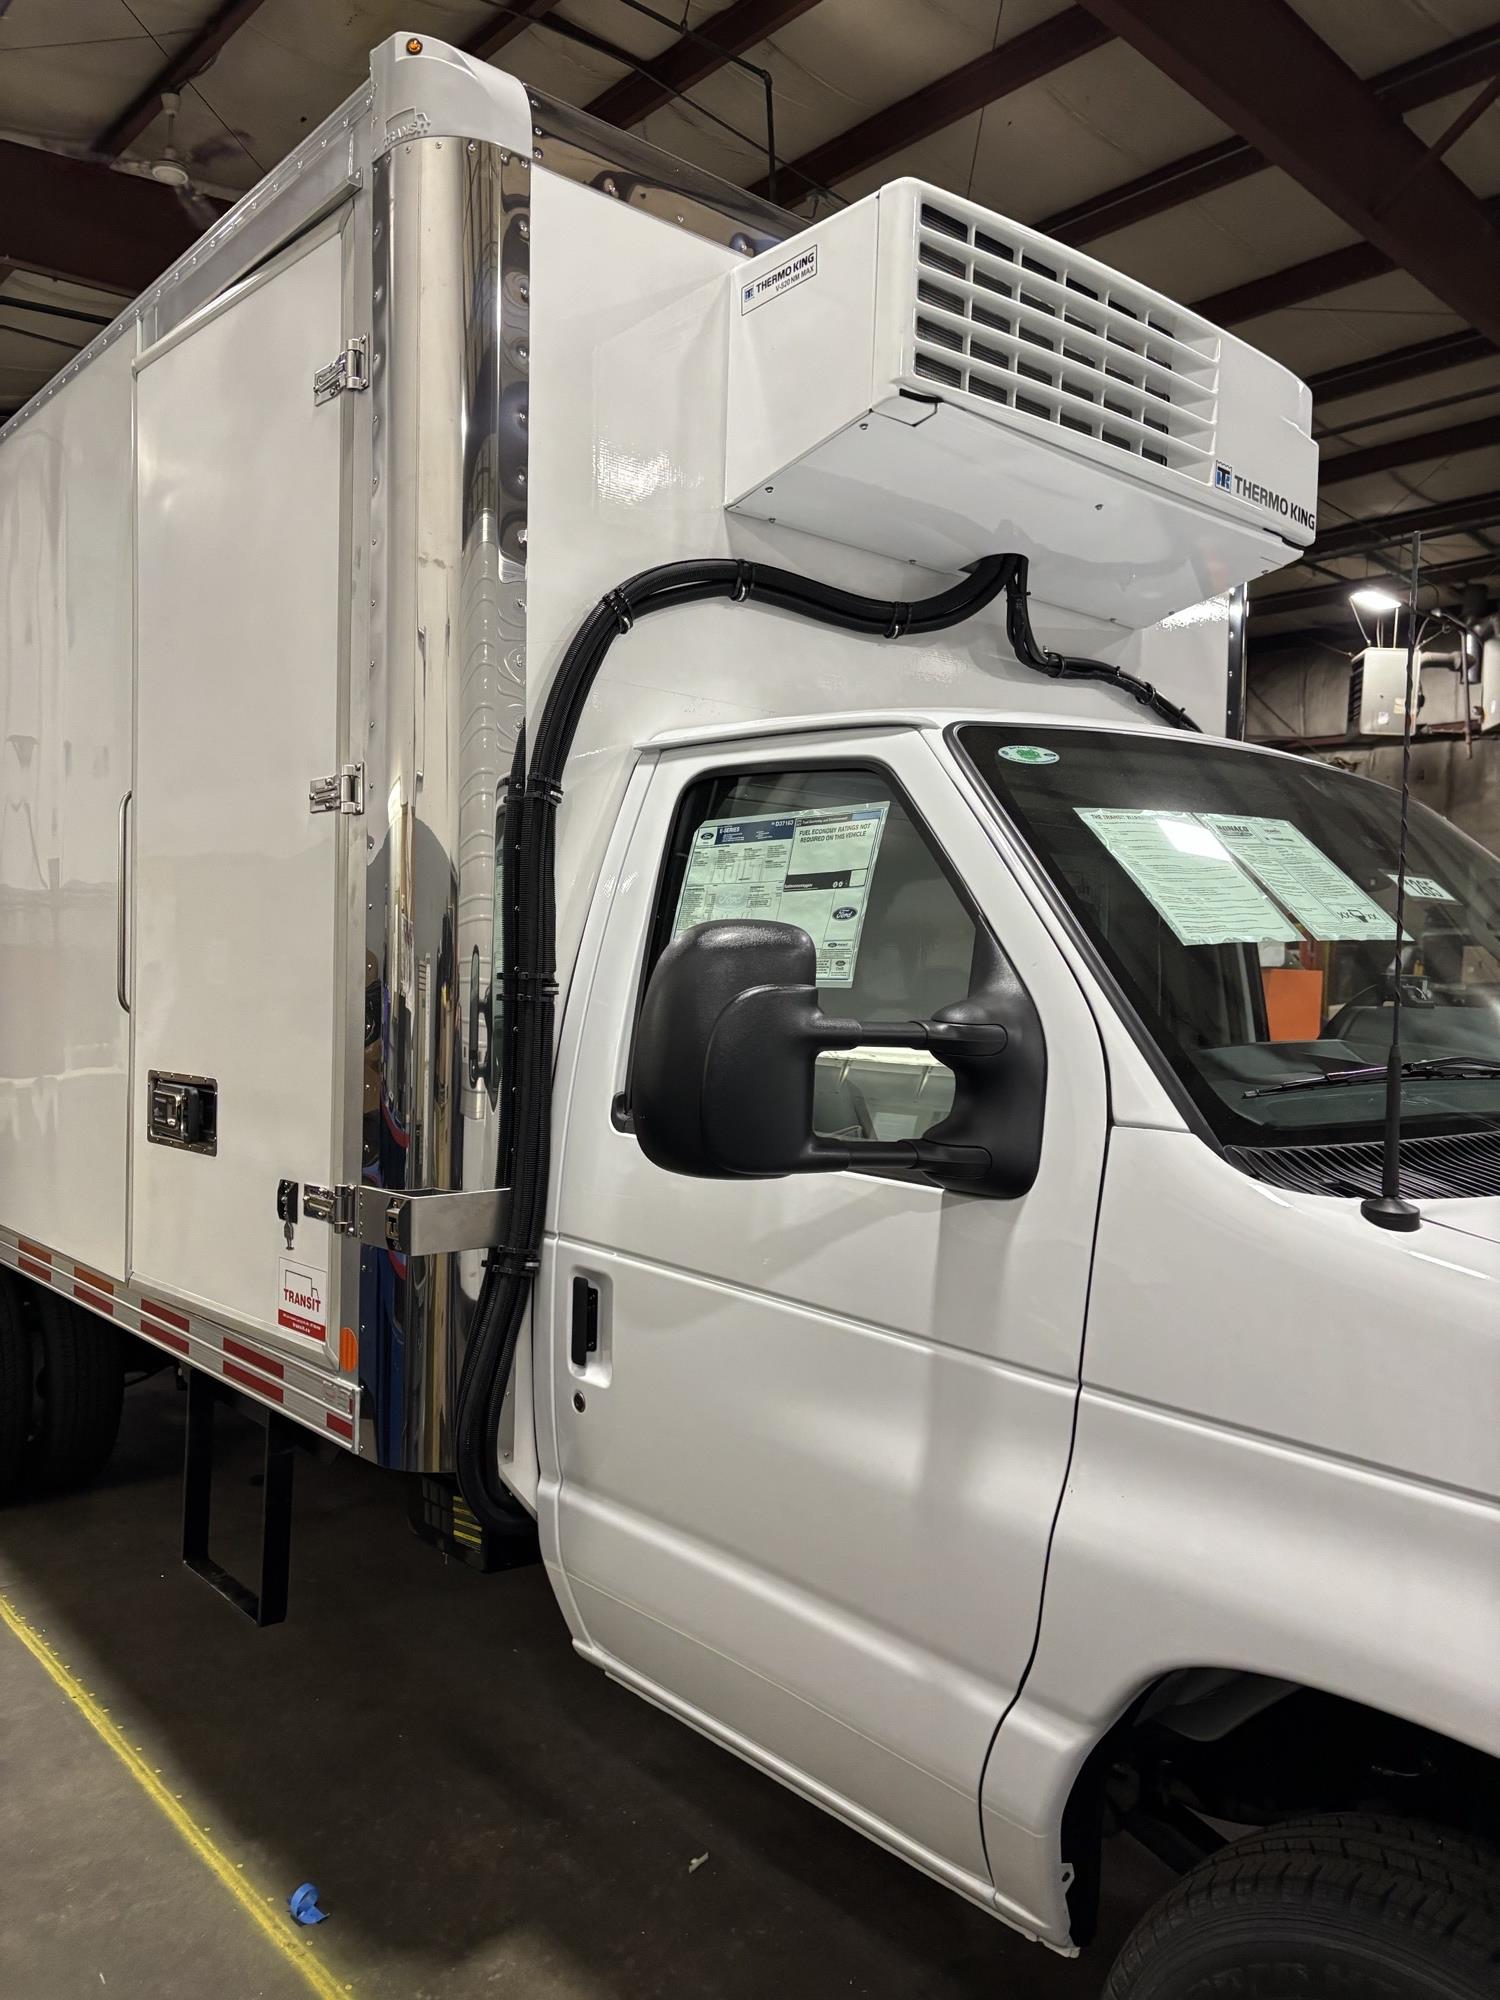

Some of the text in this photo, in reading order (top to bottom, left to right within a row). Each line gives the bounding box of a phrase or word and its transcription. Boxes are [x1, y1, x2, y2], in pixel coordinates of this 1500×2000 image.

[756, 266, 792, 293] THERMO
[793, 252, 815, 273] KING
[801, 265, 815, 278] MAX
[1234, 475, 1288, 515] THERMO
[1291, 503, 1315, 531] KING
[800, 835, 825, 843] REQUIRED
[845, 831, 867, 839] VEHICLE
[811, 826, 837, 835] ECONOMY
[837, 824, 859, 832] RATINGS
[284, 1288, 321, 1312] TRANSIT
